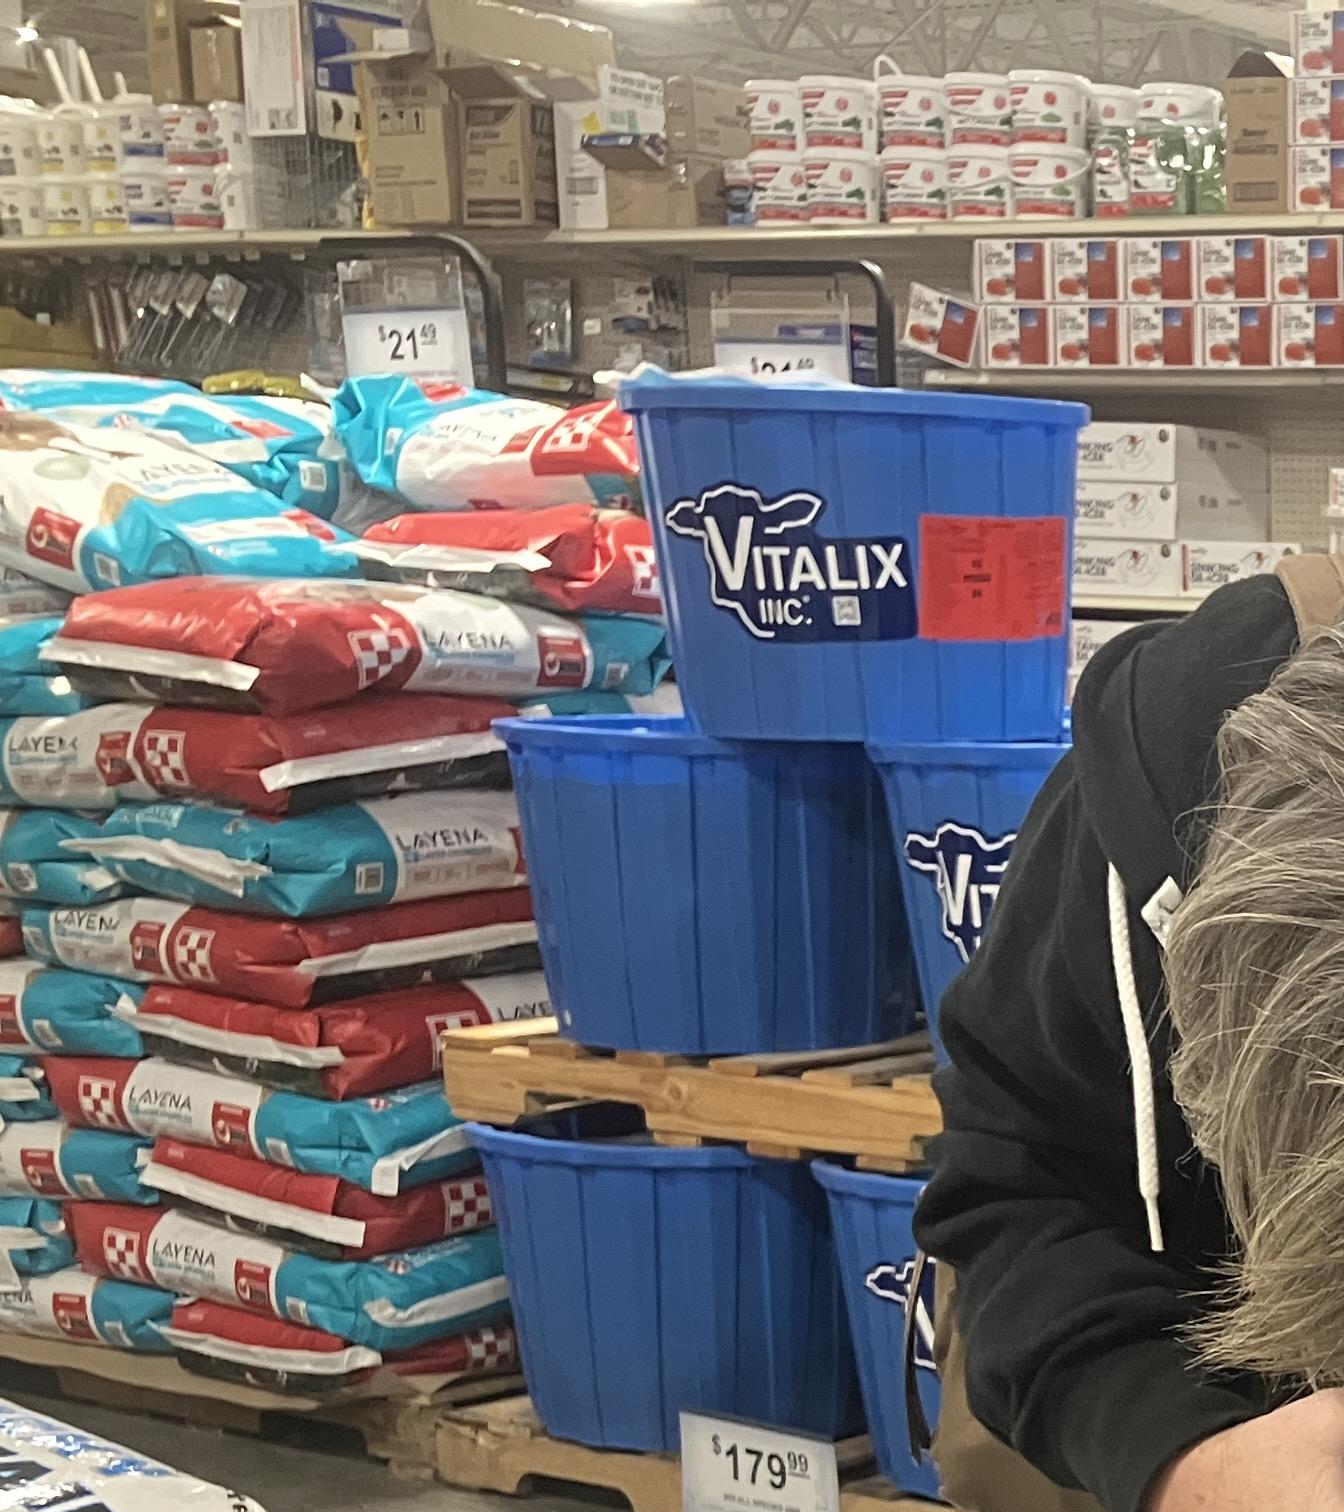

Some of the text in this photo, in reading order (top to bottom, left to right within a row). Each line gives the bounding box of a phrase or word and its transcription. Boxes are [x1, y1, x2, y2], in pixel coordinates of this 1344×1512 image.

[704, 515, 908, 591] VITALIX
[129, 1086, 192, 1111] LAYENA
[152, 1239, 216, 1266] LAYENA
